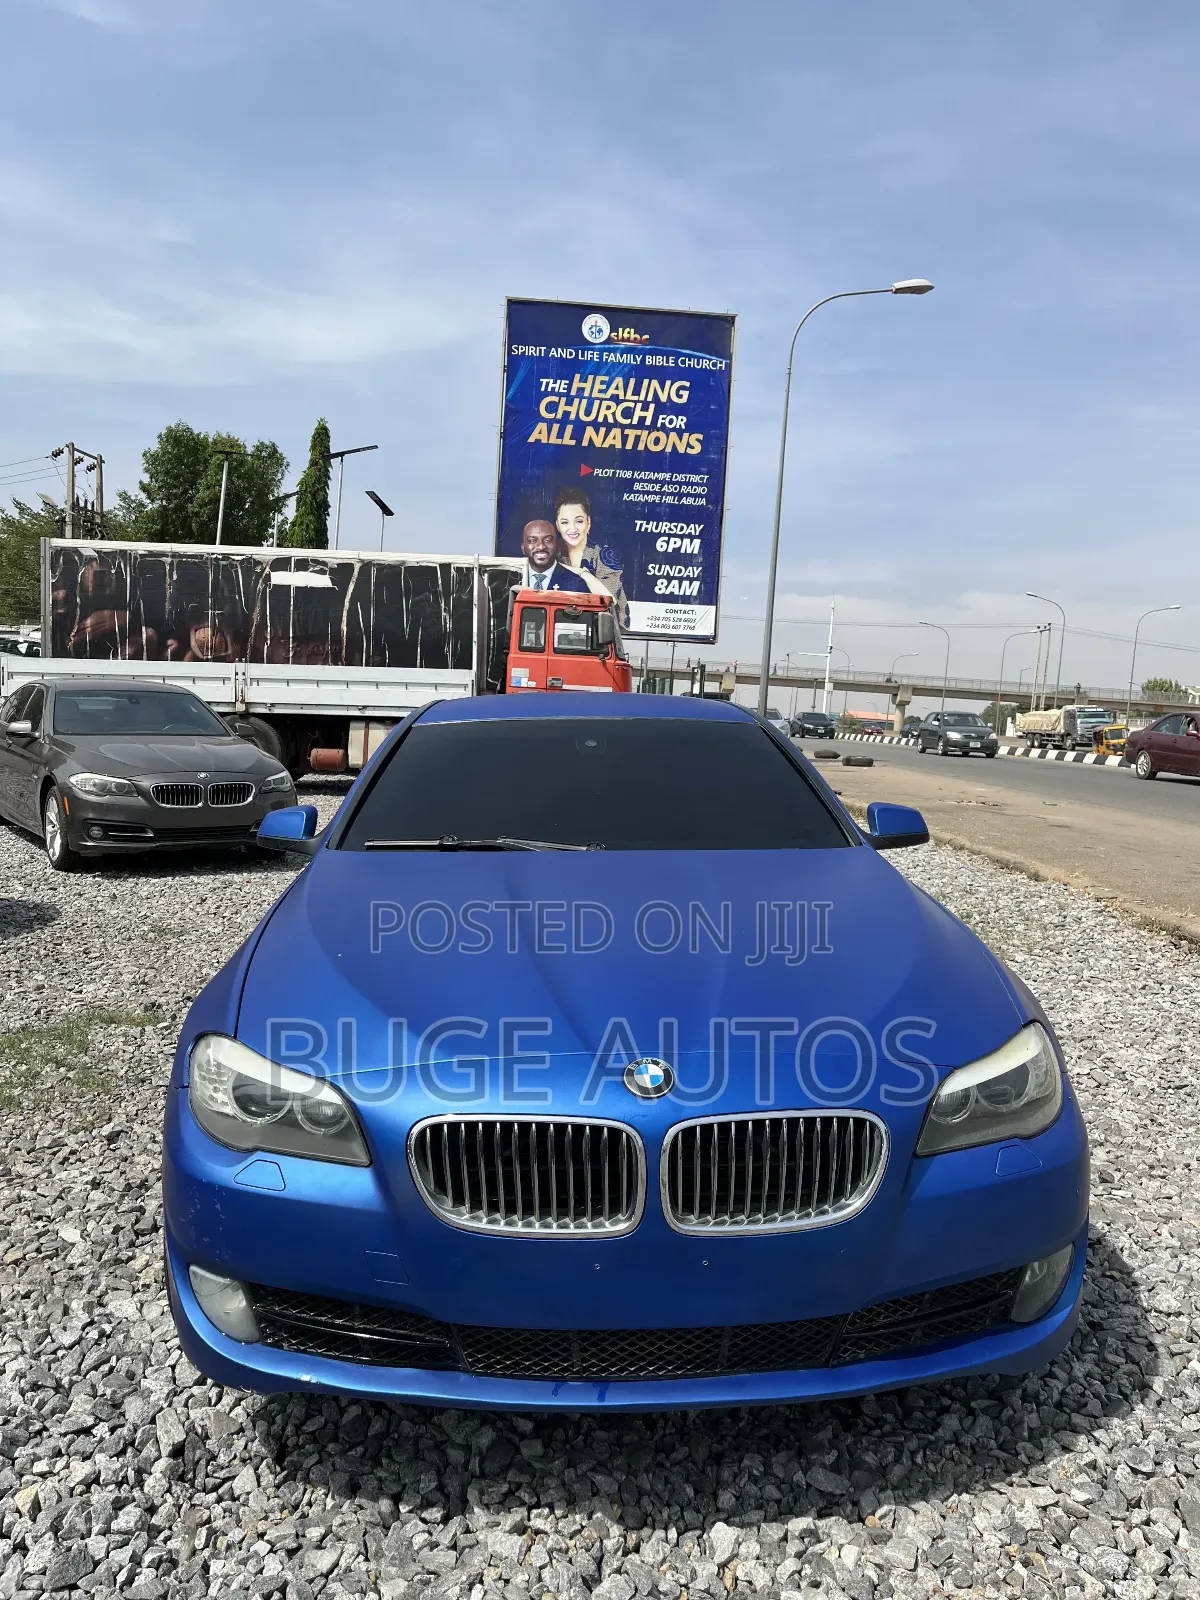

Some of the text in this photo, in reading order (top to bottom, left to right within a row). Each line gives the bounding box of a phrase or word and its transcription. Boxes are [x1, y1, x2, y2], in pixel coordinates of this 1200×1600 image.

[511, 344, 725, 370] SPIRIT AND LIFE FAMILY BIBLE CHURCH
[540, 374, 690, 403] THE HEALING
[539, 396, 687, 429] CHURCH FOR
[527, 422, 704, 454] ALL NATIONS
[593, 468, 709, 483] PLOT 1108 KATAMPE DISTRICT
[633, 482, 707, 495] BESIDE ASO RADIO
[623, 493, 706, 506] KATAMPE HILL ABUJA
[634, 520, 704, 536] THURSDAY
[656, 536, 701, 554] 6PM
[647, 564, 702, 578] SUNDAY
[654, 579, 700, 596] 8AM
